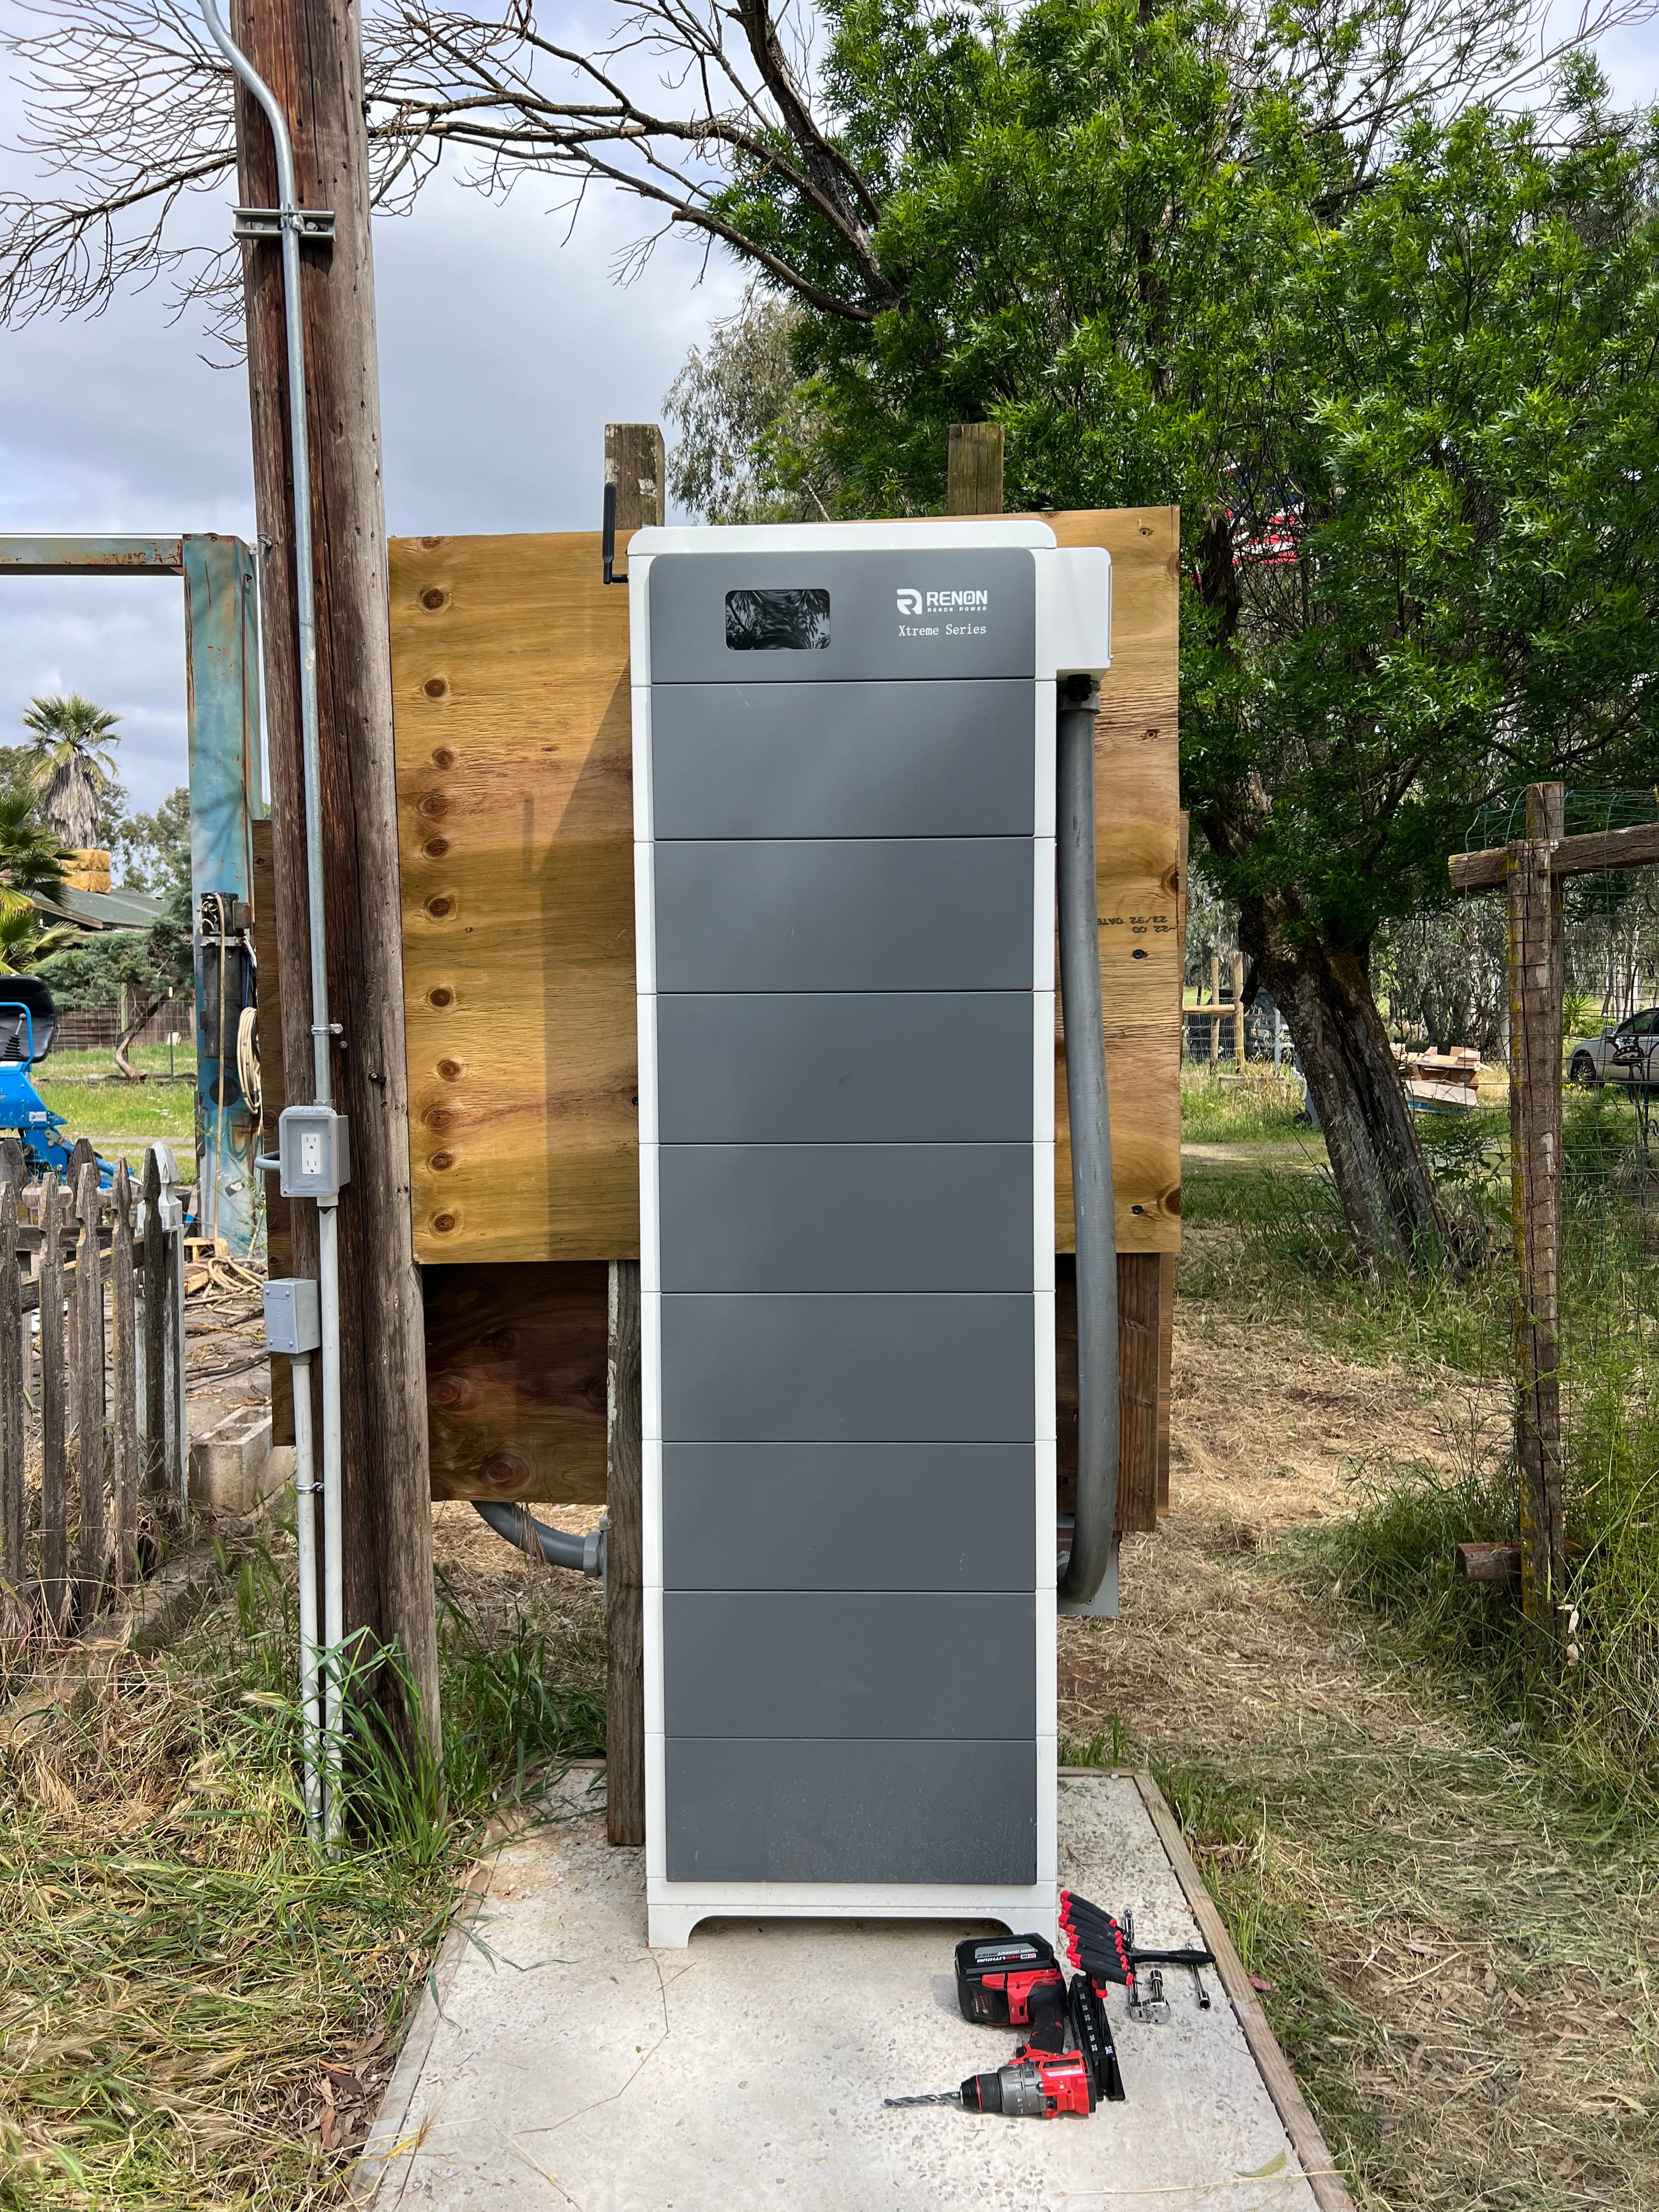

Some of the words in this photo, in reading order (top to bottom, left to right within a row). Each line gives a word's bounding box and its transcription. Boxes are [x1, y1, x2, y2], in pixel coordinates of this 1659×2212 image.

[926, 590, 988, 606] RENON
[898, 625, 939, 636] Xtreme
[945, 623, 986, 635] Series
[1128, 916, 1167, 924] 23/32
